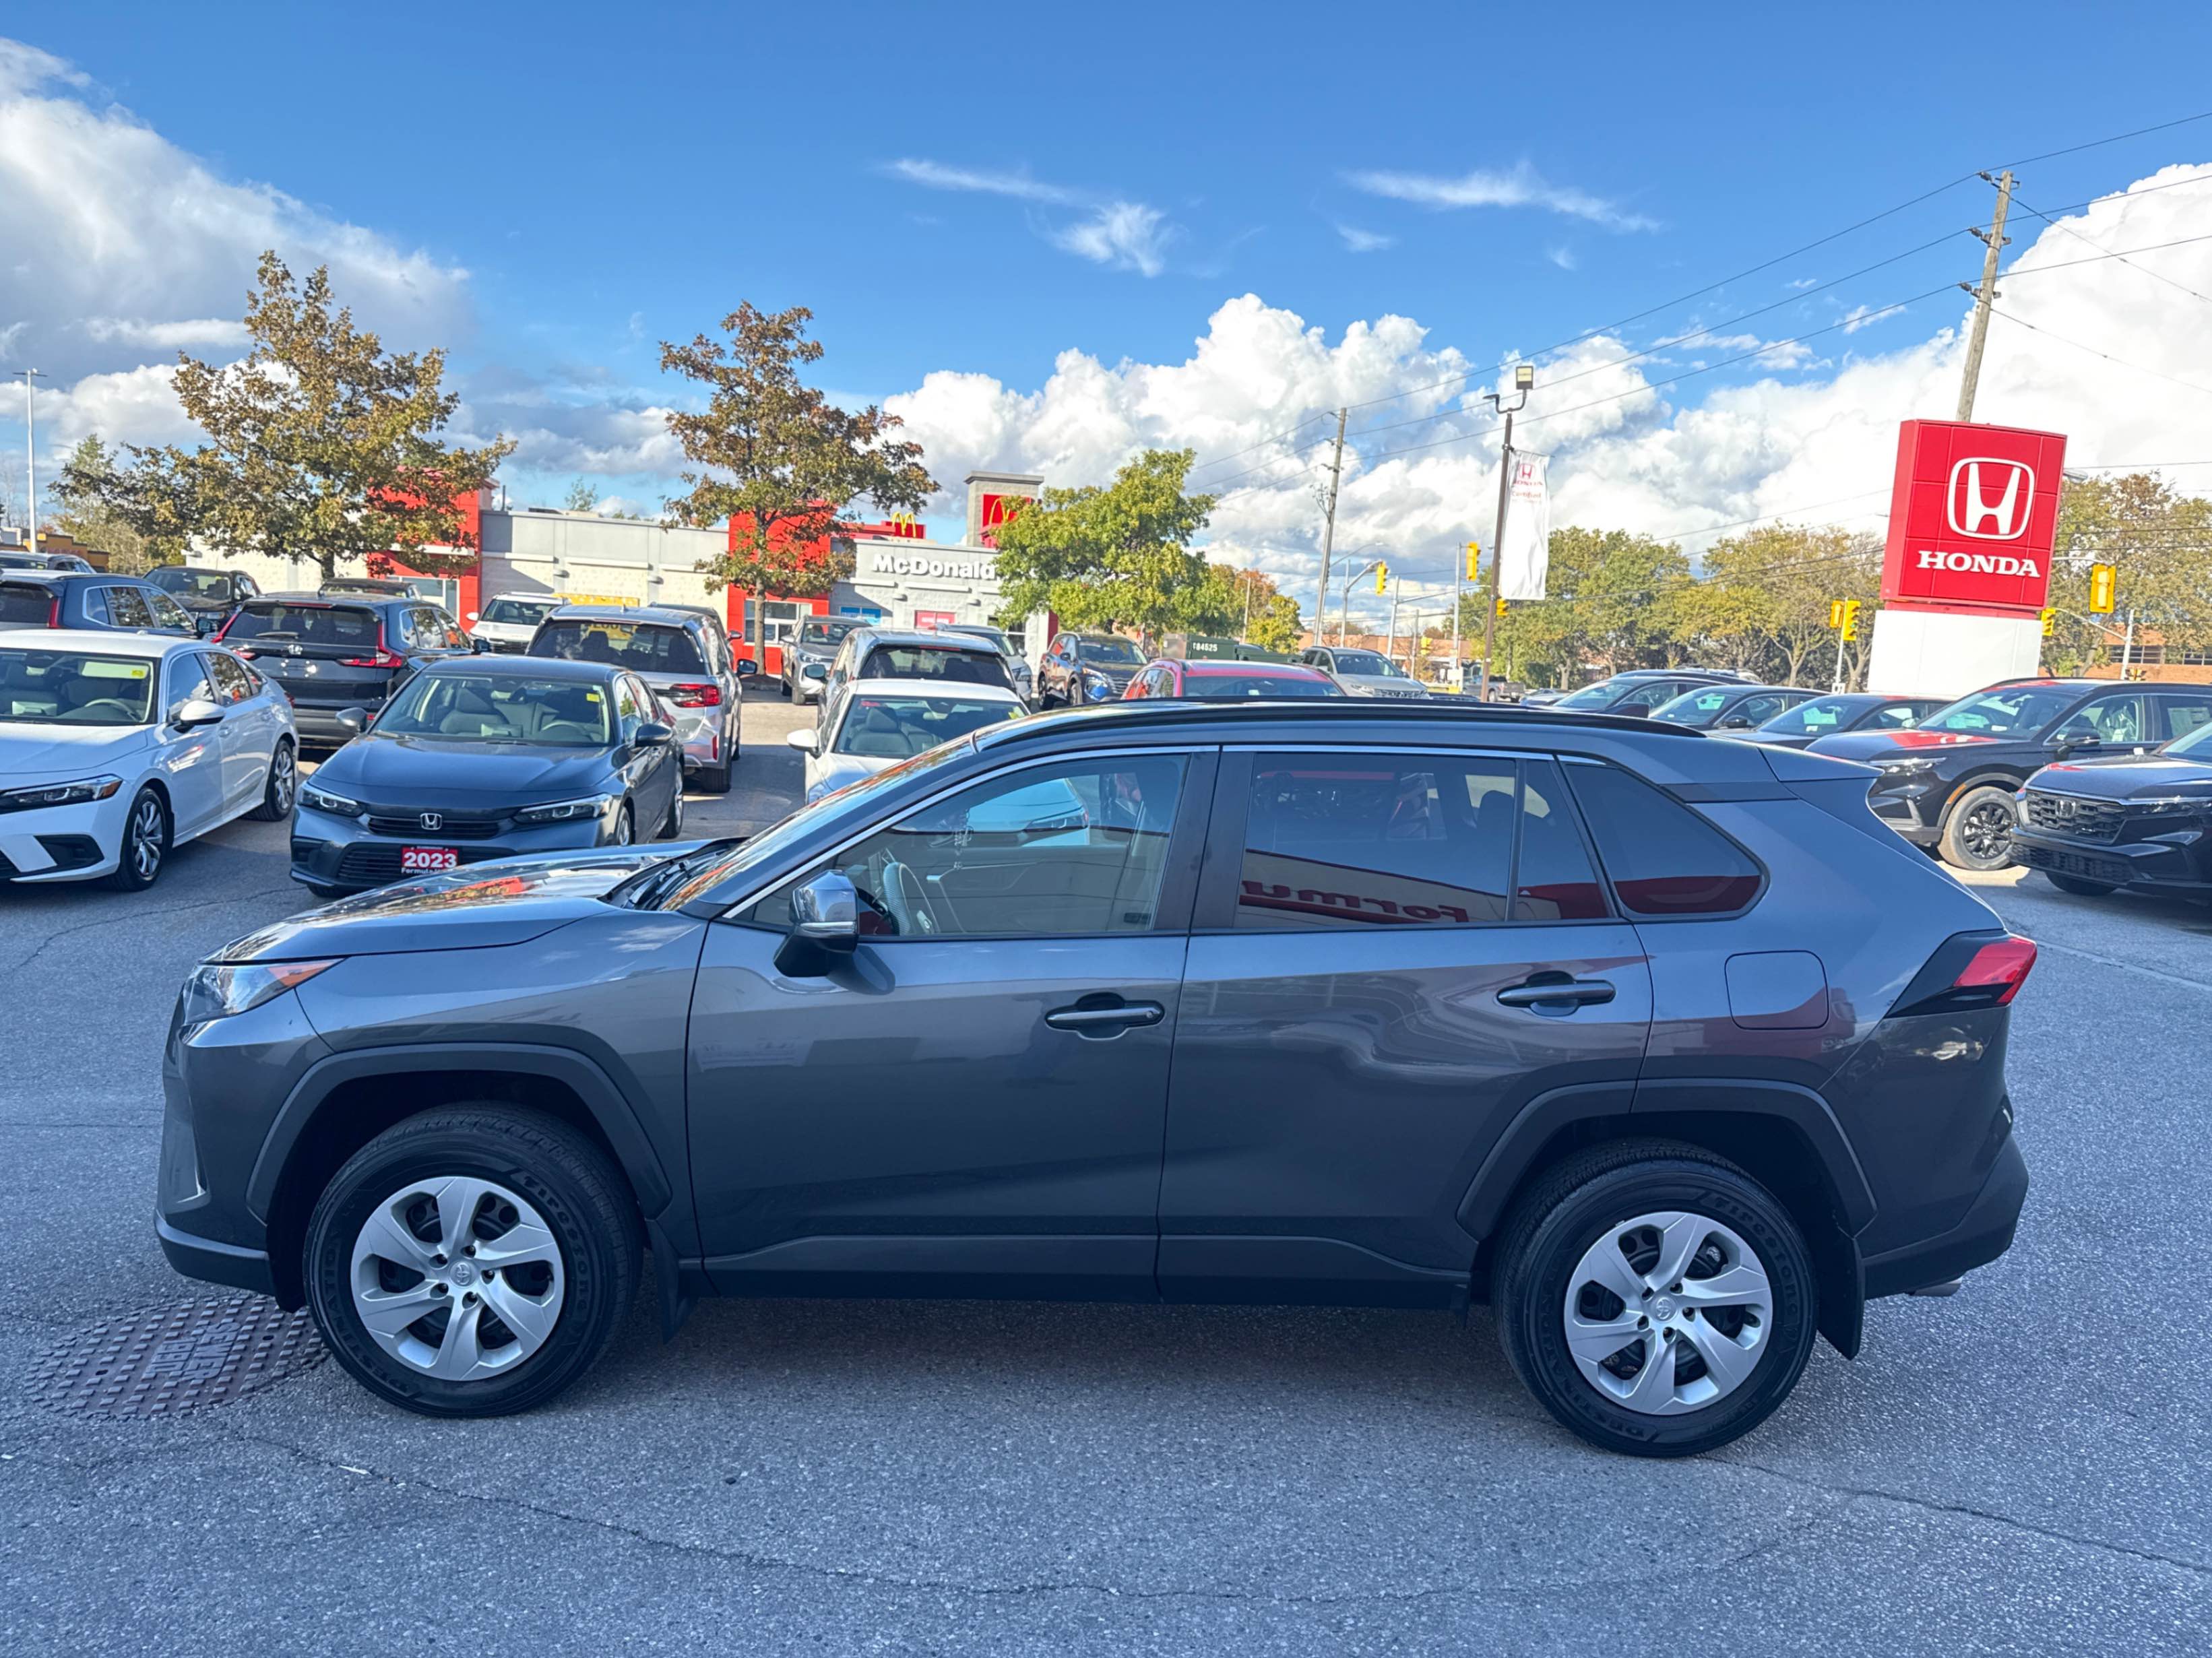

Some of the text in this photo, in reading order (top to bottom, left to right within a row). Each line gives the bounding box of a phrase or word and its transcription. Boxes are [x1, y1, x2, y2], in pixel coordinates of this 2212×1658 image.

[1916, 550, 2041, 578] HONDA
[404, 852, 457, 868] 2023
[522, 1174, 589, 1311] Firestone
[1714, 1197, 1798, 1316] Firestone
[178, 1322, 242, 1382] SEWER
